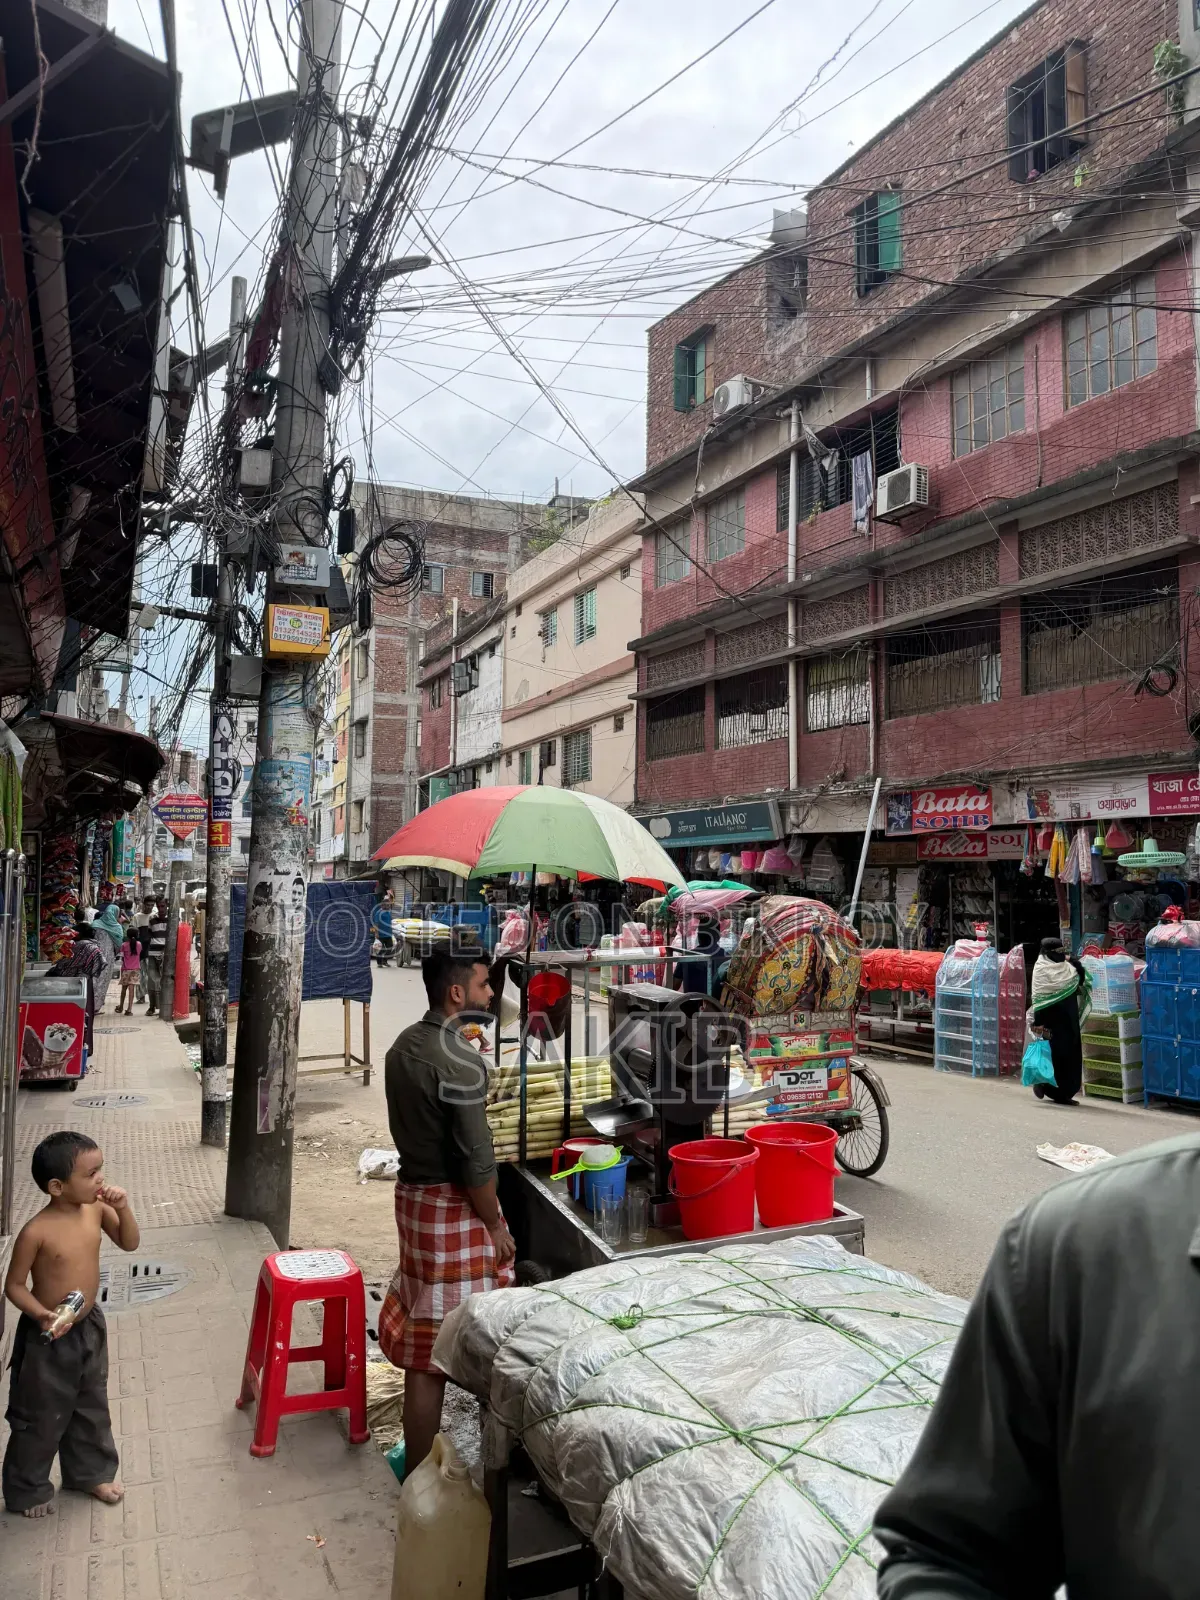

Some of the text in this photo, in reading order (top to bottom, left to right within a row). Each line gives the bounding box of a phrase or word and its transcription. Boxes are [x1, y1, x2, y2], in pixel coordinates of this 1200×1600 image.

[1152, 779, 1184, 794] খাজা
[914, 790, 990, 813] Bata
[704, 812, 746, 827] ITALIANO
[780, 1071, 814, 1085] DOT
